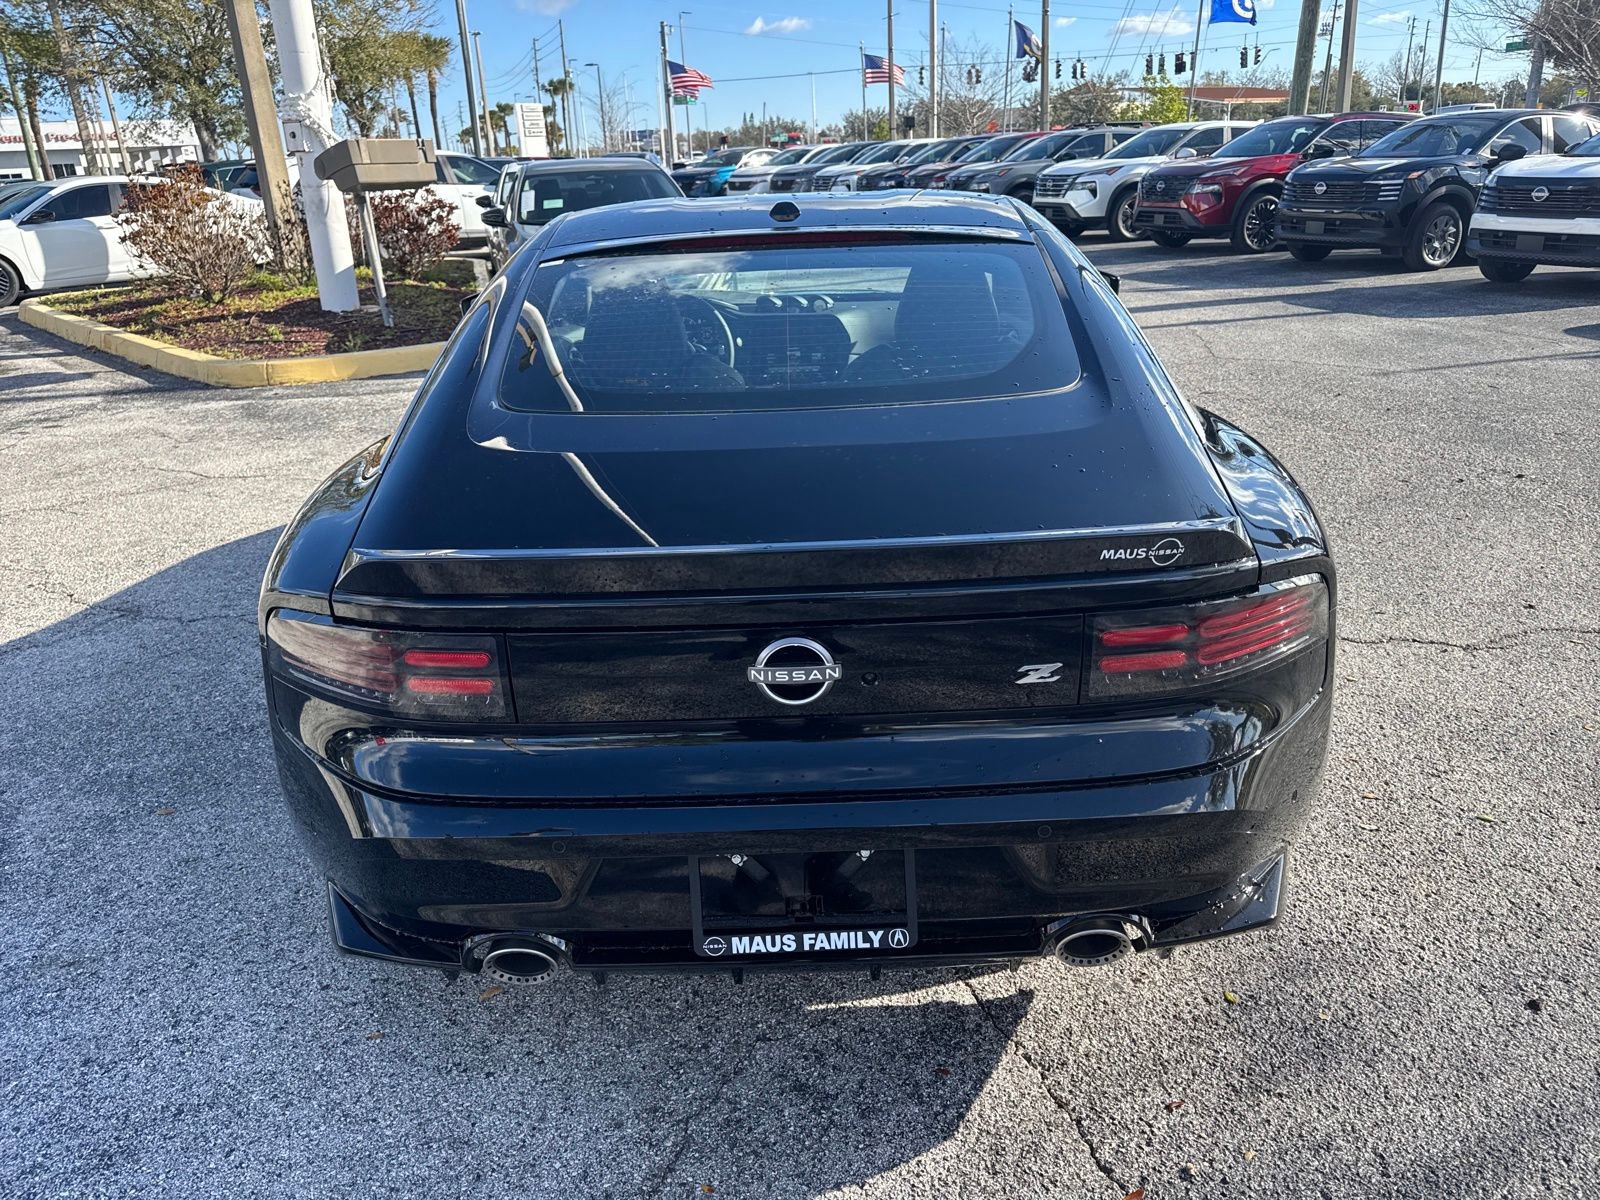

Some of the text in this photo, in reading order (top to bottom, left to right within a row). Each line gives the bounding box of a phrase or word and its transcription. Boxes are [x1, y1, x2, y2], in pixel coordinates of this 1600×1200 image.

[1100, 547, 1185, 560] MAUS NISSAN
[751, 666, 840, 682] NISSAN
[1014, 662, 1063, 684] Z
[731, 934, 797, 954] MAUS
[803, 930, 885, 950] FAMILY
